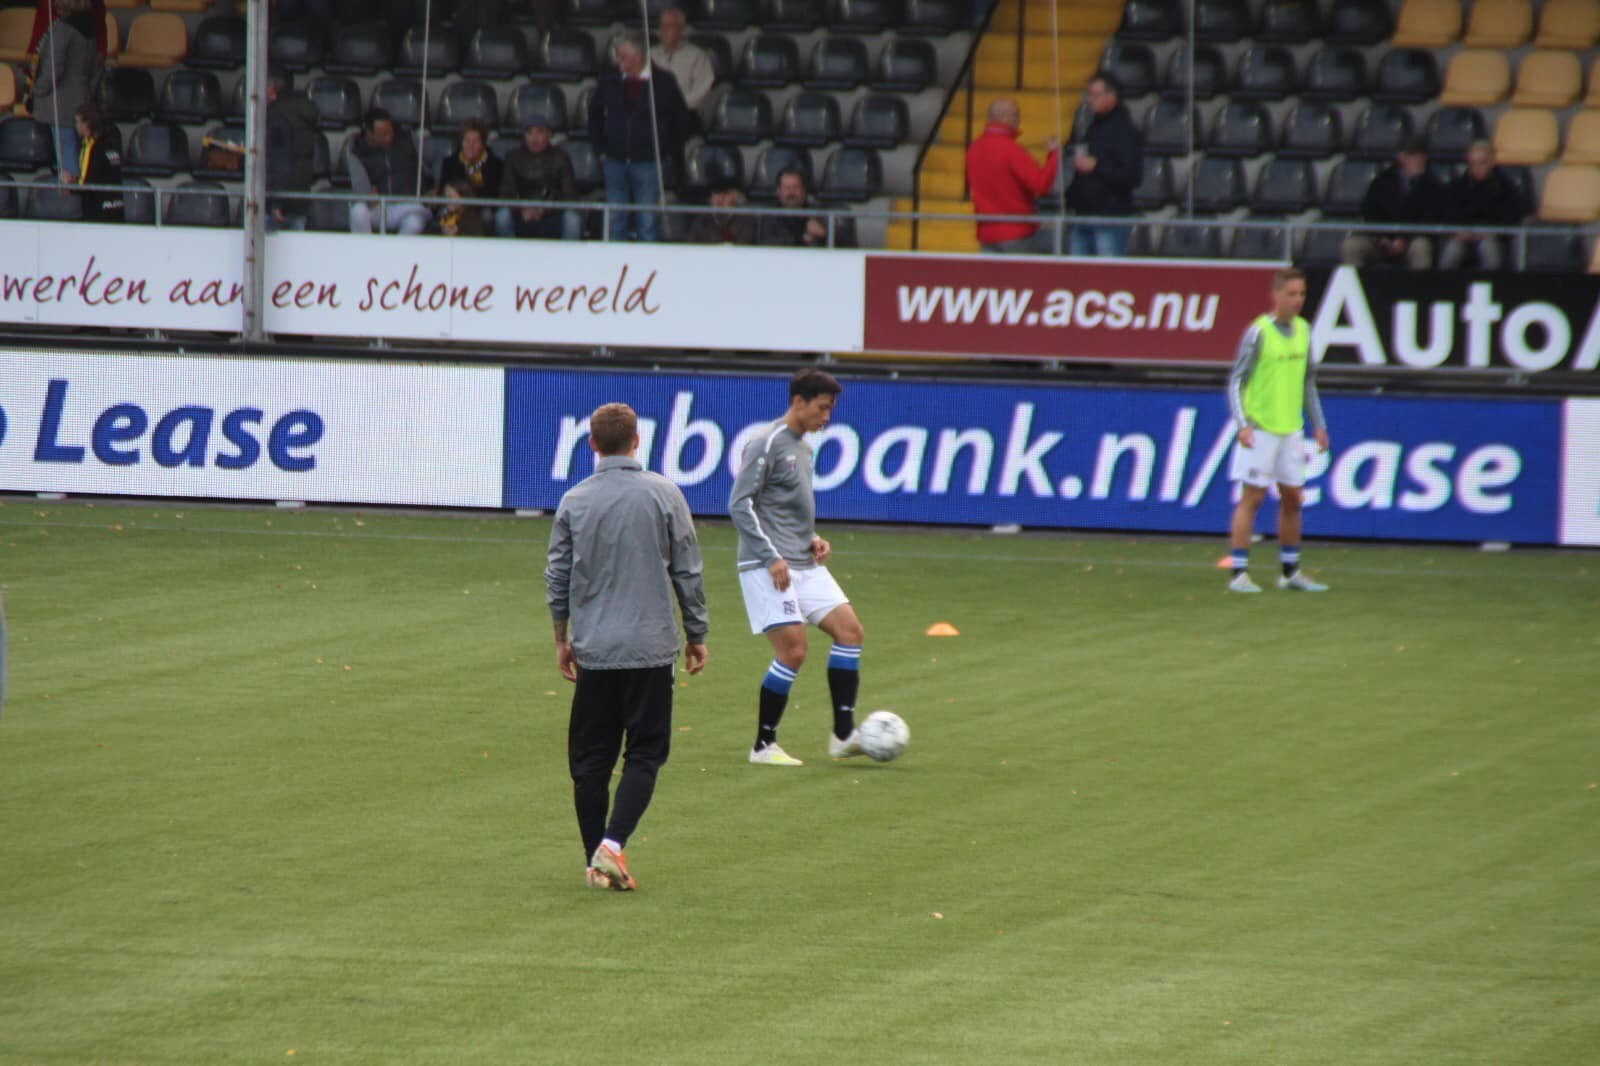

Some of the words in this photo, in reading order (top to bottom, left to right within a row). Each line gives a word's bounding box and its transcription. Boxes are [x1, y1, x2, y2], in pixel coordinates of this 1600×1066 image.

[3, 255, 151, 306] werken
[271, 280, 341, 309] een
[358, 264, 494, 312] schone
[515, 264, 660, 315] wereld
[898, 285, 1219, 331] www.acs.nu
[33, 378, 325, 472] Lease
[551, 390, 1522, 513] rbank.nl/ase
